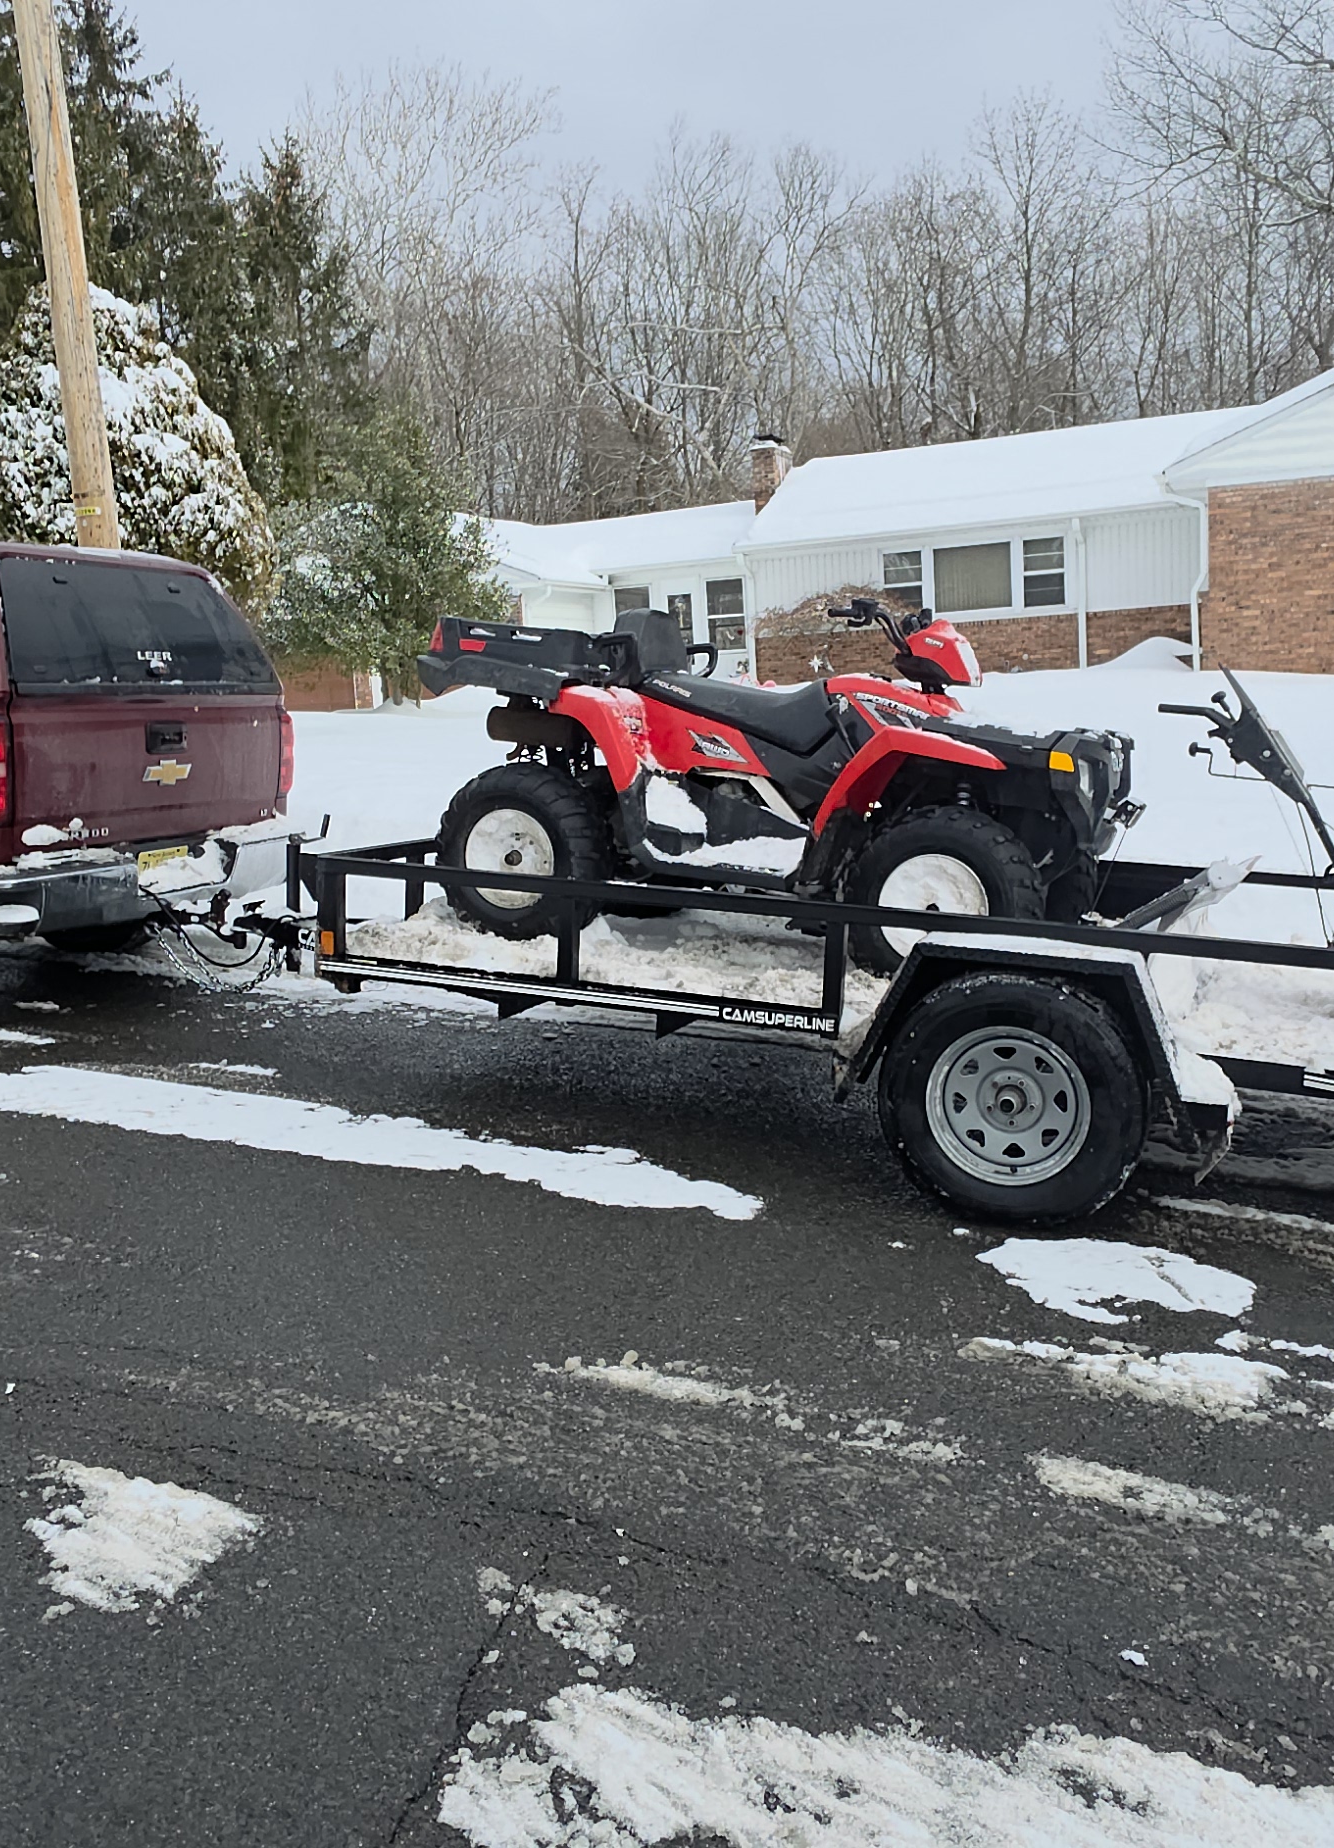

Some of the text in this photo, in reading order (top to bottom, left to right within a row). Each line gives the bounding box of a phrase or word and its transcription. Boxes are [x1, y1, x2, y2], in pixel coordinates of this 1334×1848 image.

[137, 651, 172, 661] LEER
[652, 679, 692, 697] POLARIS
[298, 928, 315, 946] CA
[722, 1007, 835, 1032] CAMSUPERLINE
